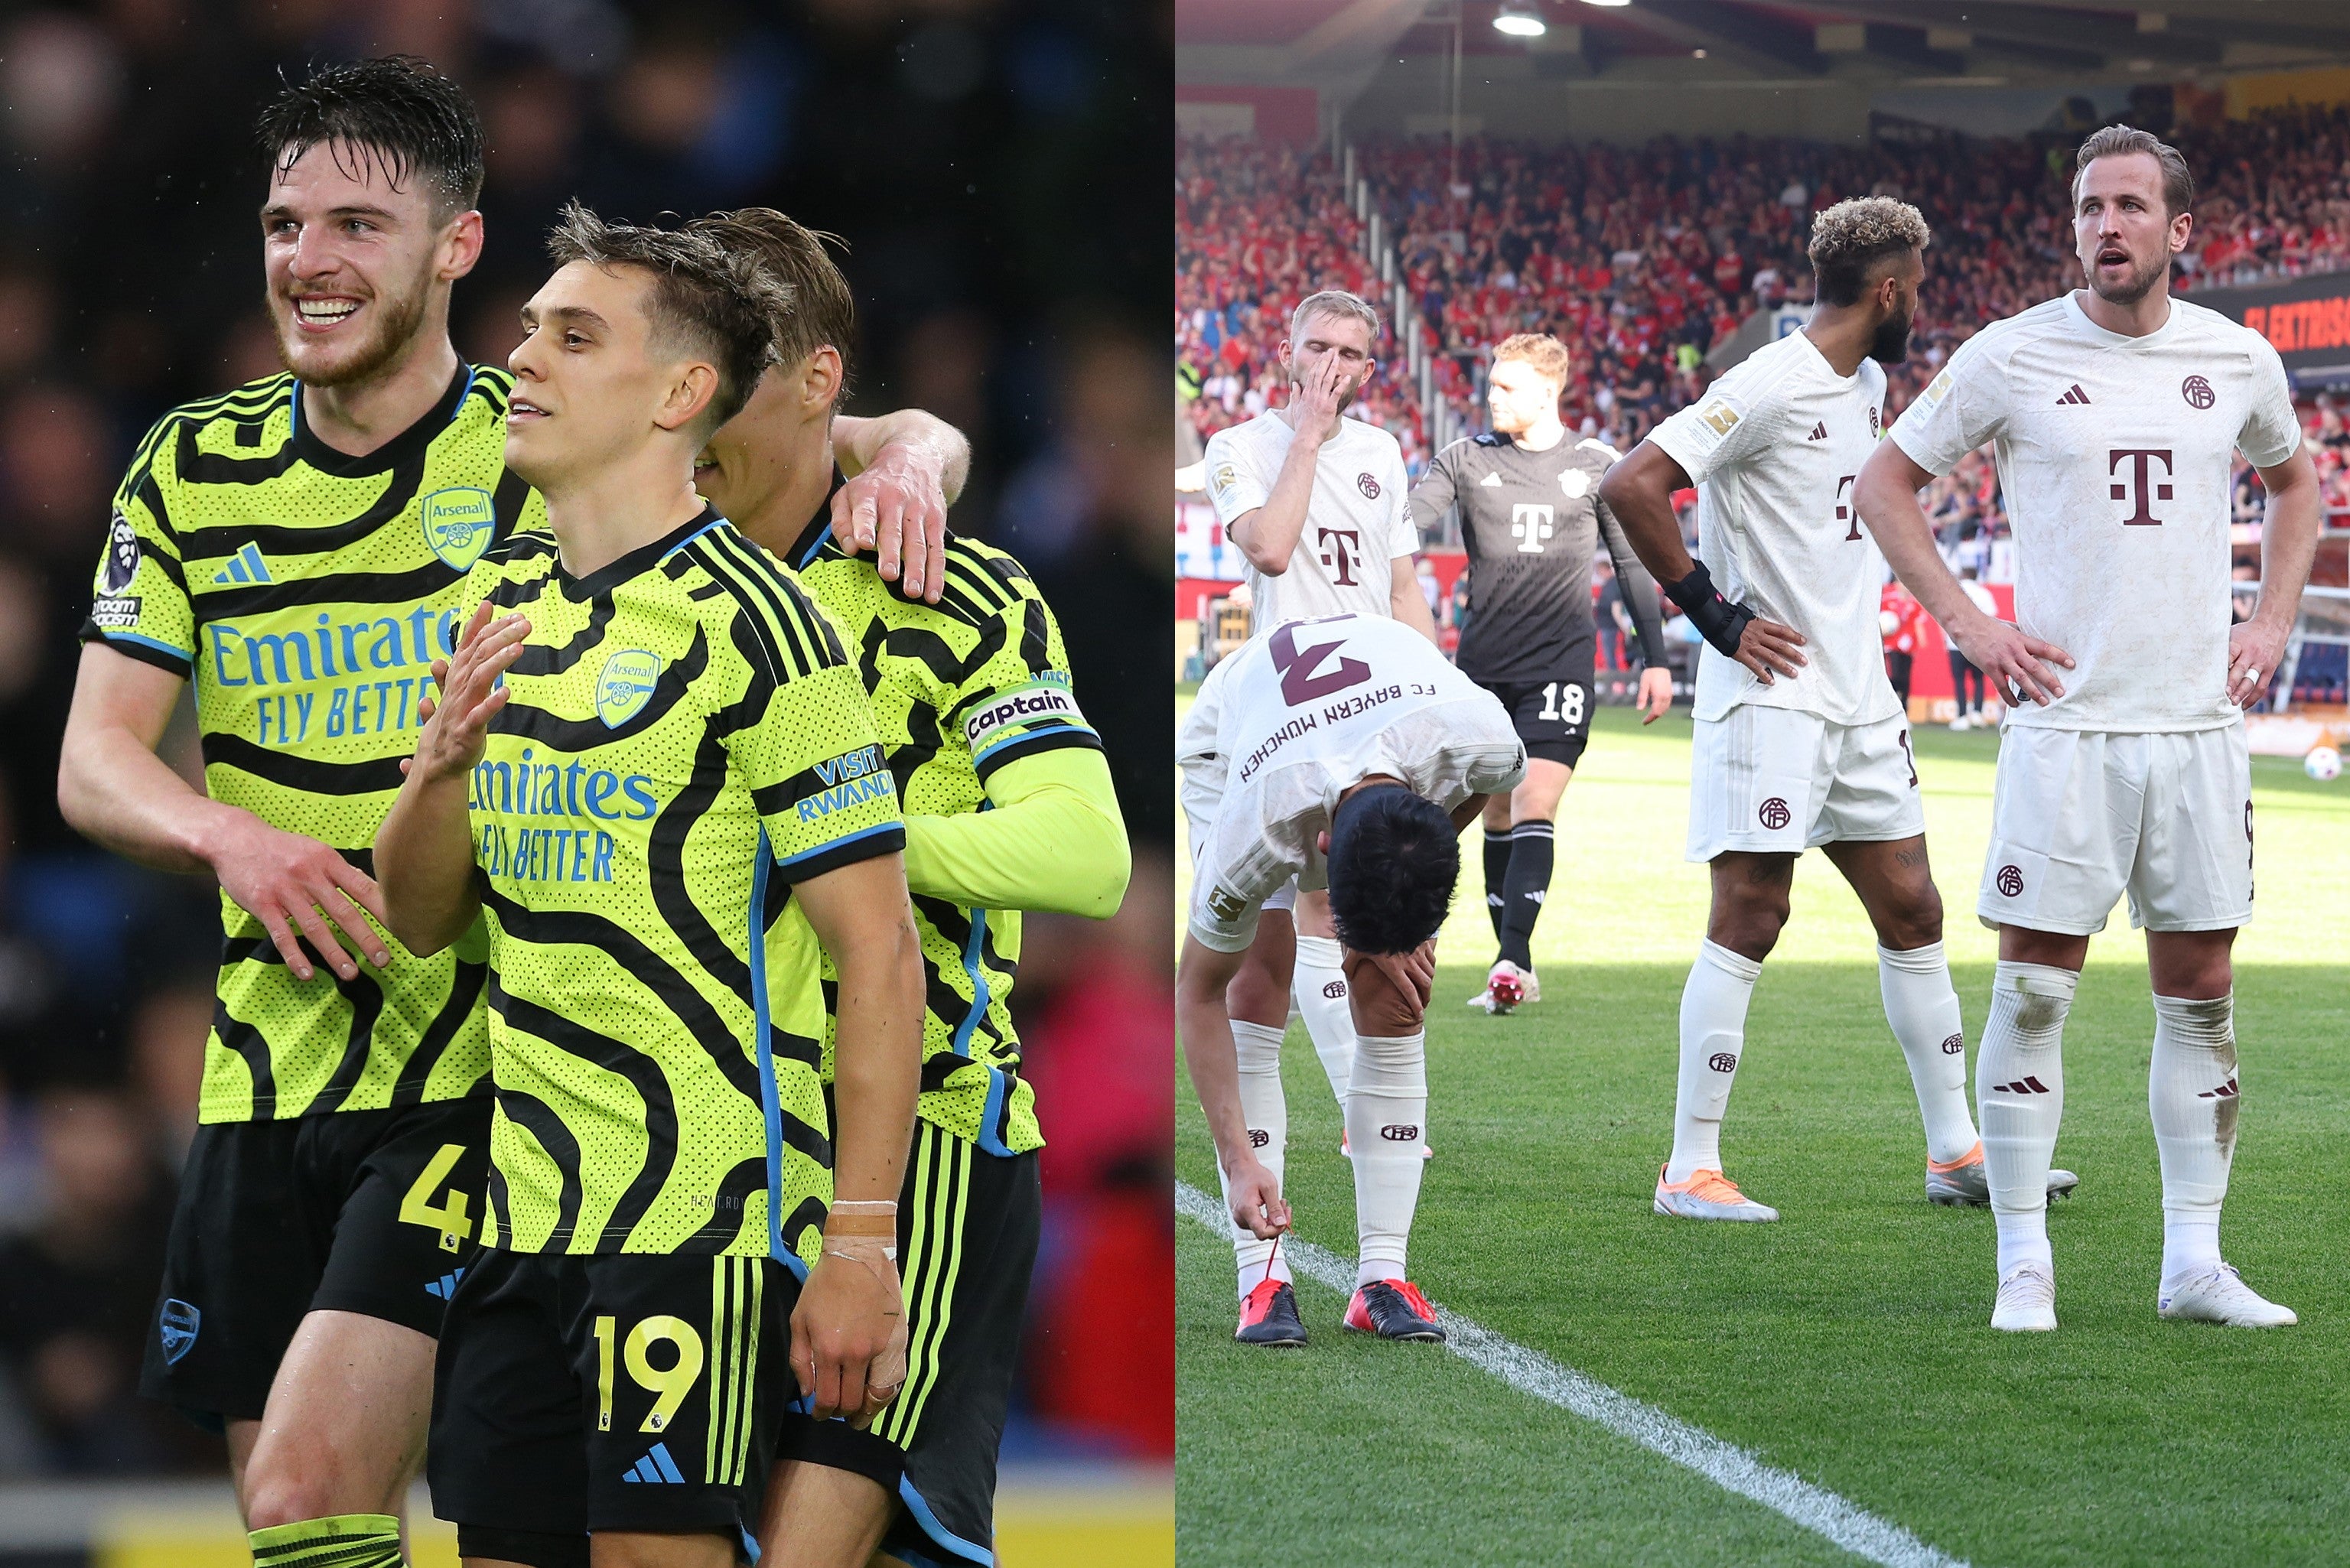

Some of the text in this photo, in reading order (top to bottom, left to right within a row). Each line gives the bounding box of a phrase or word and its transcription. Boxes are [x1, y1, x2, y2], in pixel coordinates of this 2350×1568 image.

[433, 501, 483, 517] Arsenal
[2110, 450, 2173, 525] T
[1512, 503, 1554, 553] T
[1318, 528, 1361, 587] T
[96, 600, 136, 613] room
[612, 662, 652, 678] Arsenal
[258, 691, 324, 745] FLY
[968, 690, 1069, 740] captain
[1538, 682, 1584, 725] 18
[1239, 684, 1437, 783] FC BAYERN MÜNCHEN
[469, 748, 658, 821] mirates
[813, 745, 878, 786] VISIT
[513, 828, 614, 882] BETTER
[398, 1143, 472, 1254] 4
[594, 1315, 704, 1433] 19
